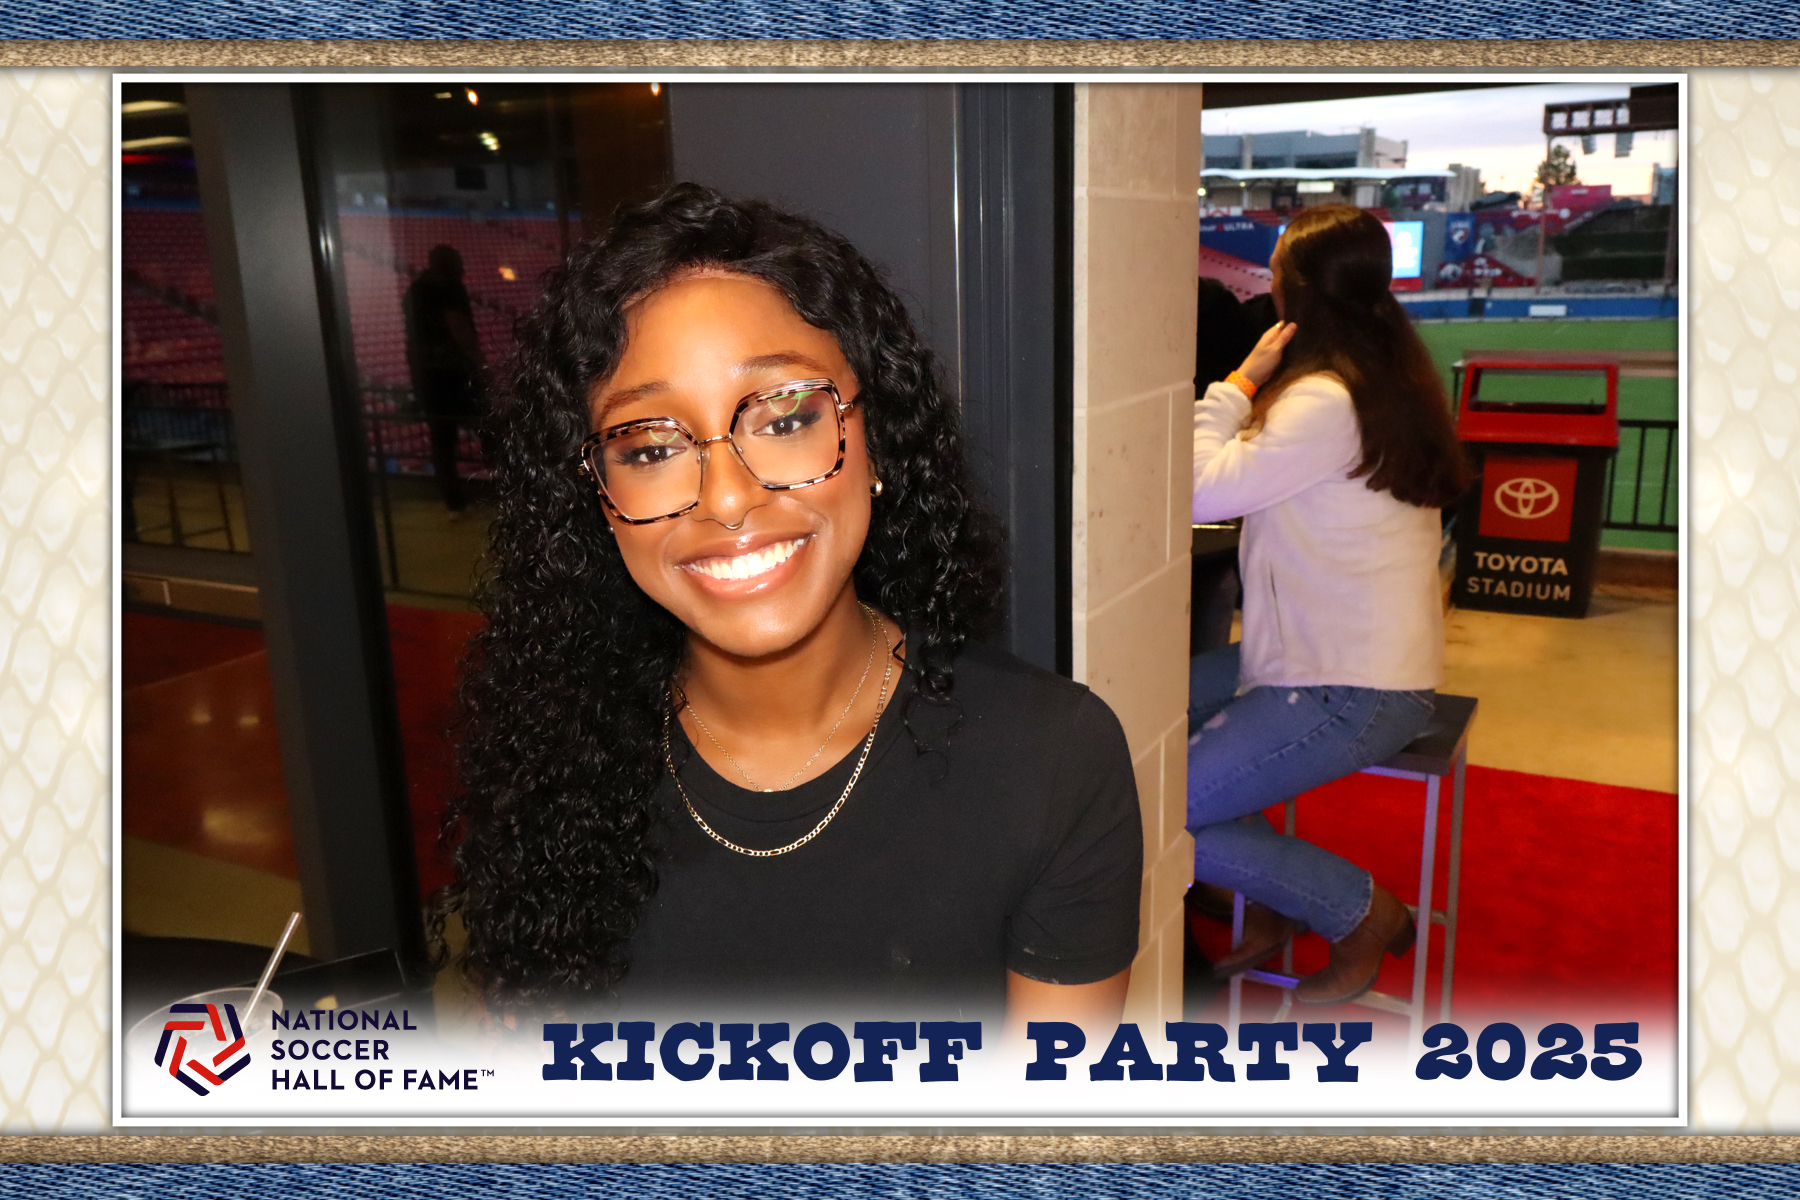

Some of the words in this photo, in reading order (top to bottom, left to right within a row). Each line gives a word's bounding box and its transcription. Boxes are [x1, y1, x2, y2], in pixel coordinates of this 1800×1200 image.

[1223, 222, 1255, 231] ULTRA
[1474, 551, 1569, 576] TOYOTA
[1467, 576, 1571, 601] STADIUM
